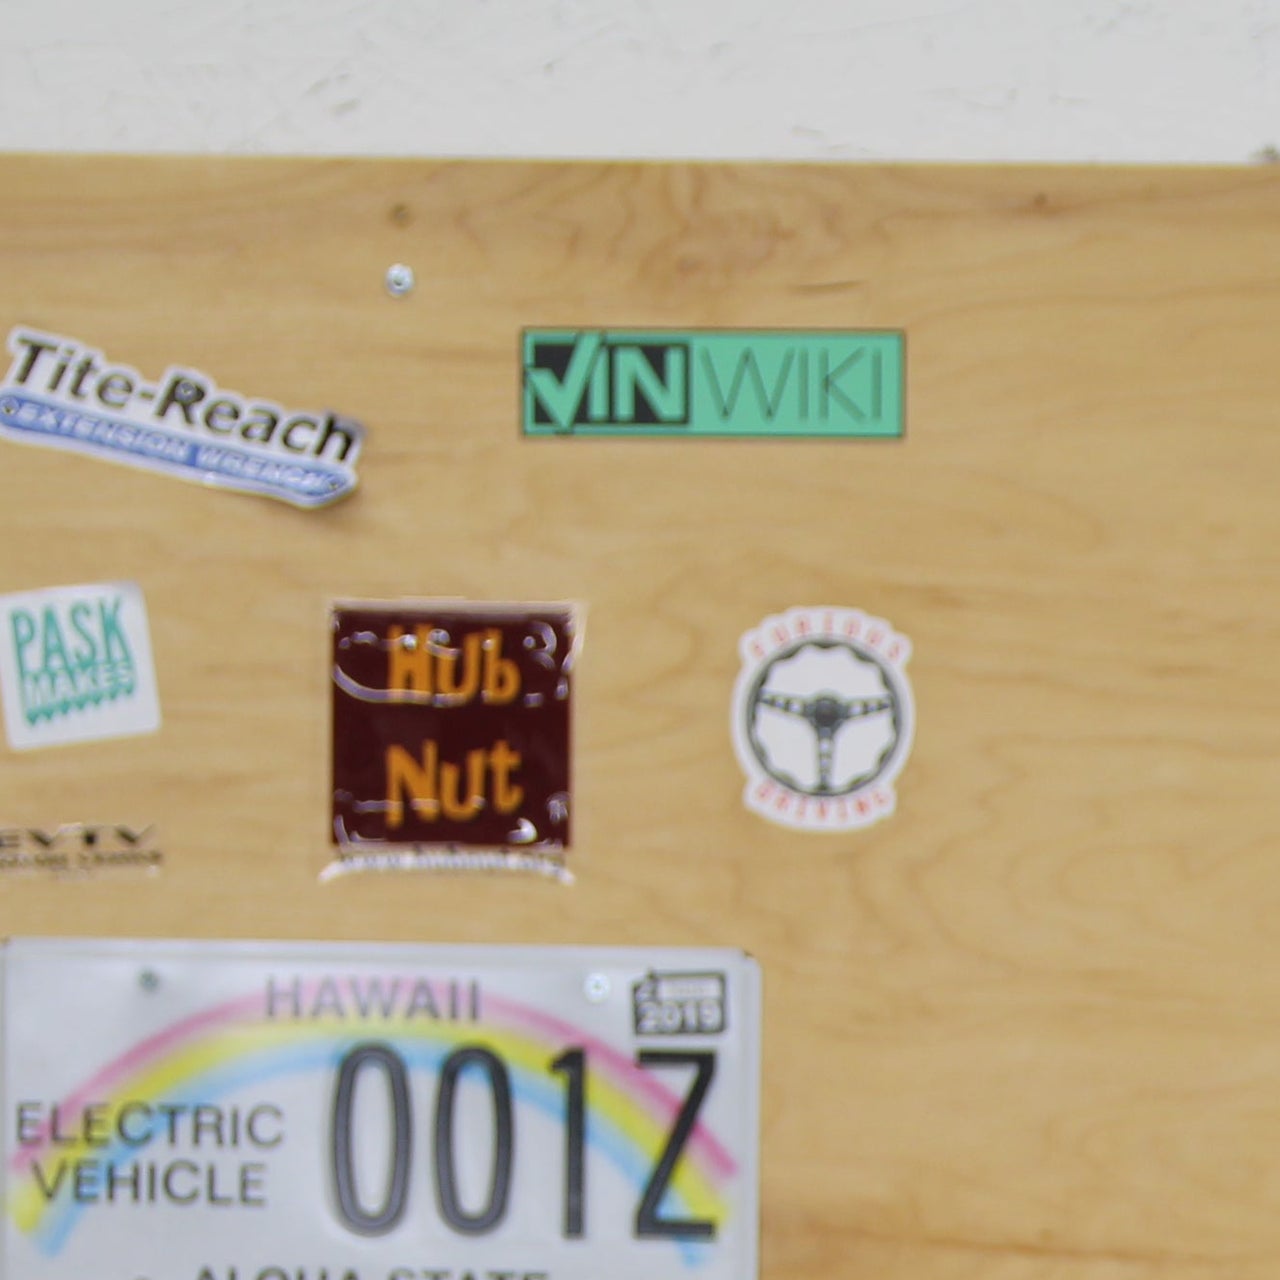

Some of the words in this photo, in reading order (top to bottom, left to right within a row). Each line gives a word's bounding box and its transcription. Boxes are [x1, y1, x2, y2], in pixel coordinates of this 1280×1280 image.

[16, 335, 356, 462] Tite-Reach
[11, 595, 132, 677] PASK
[265, 975, 481, 1021] HAWAII
[15, 1101, 285, 1149] ELECTRIC
[332, 1039, 719, 1242] 001Z
[31, 1158, 269, 1207] VEHICLE
